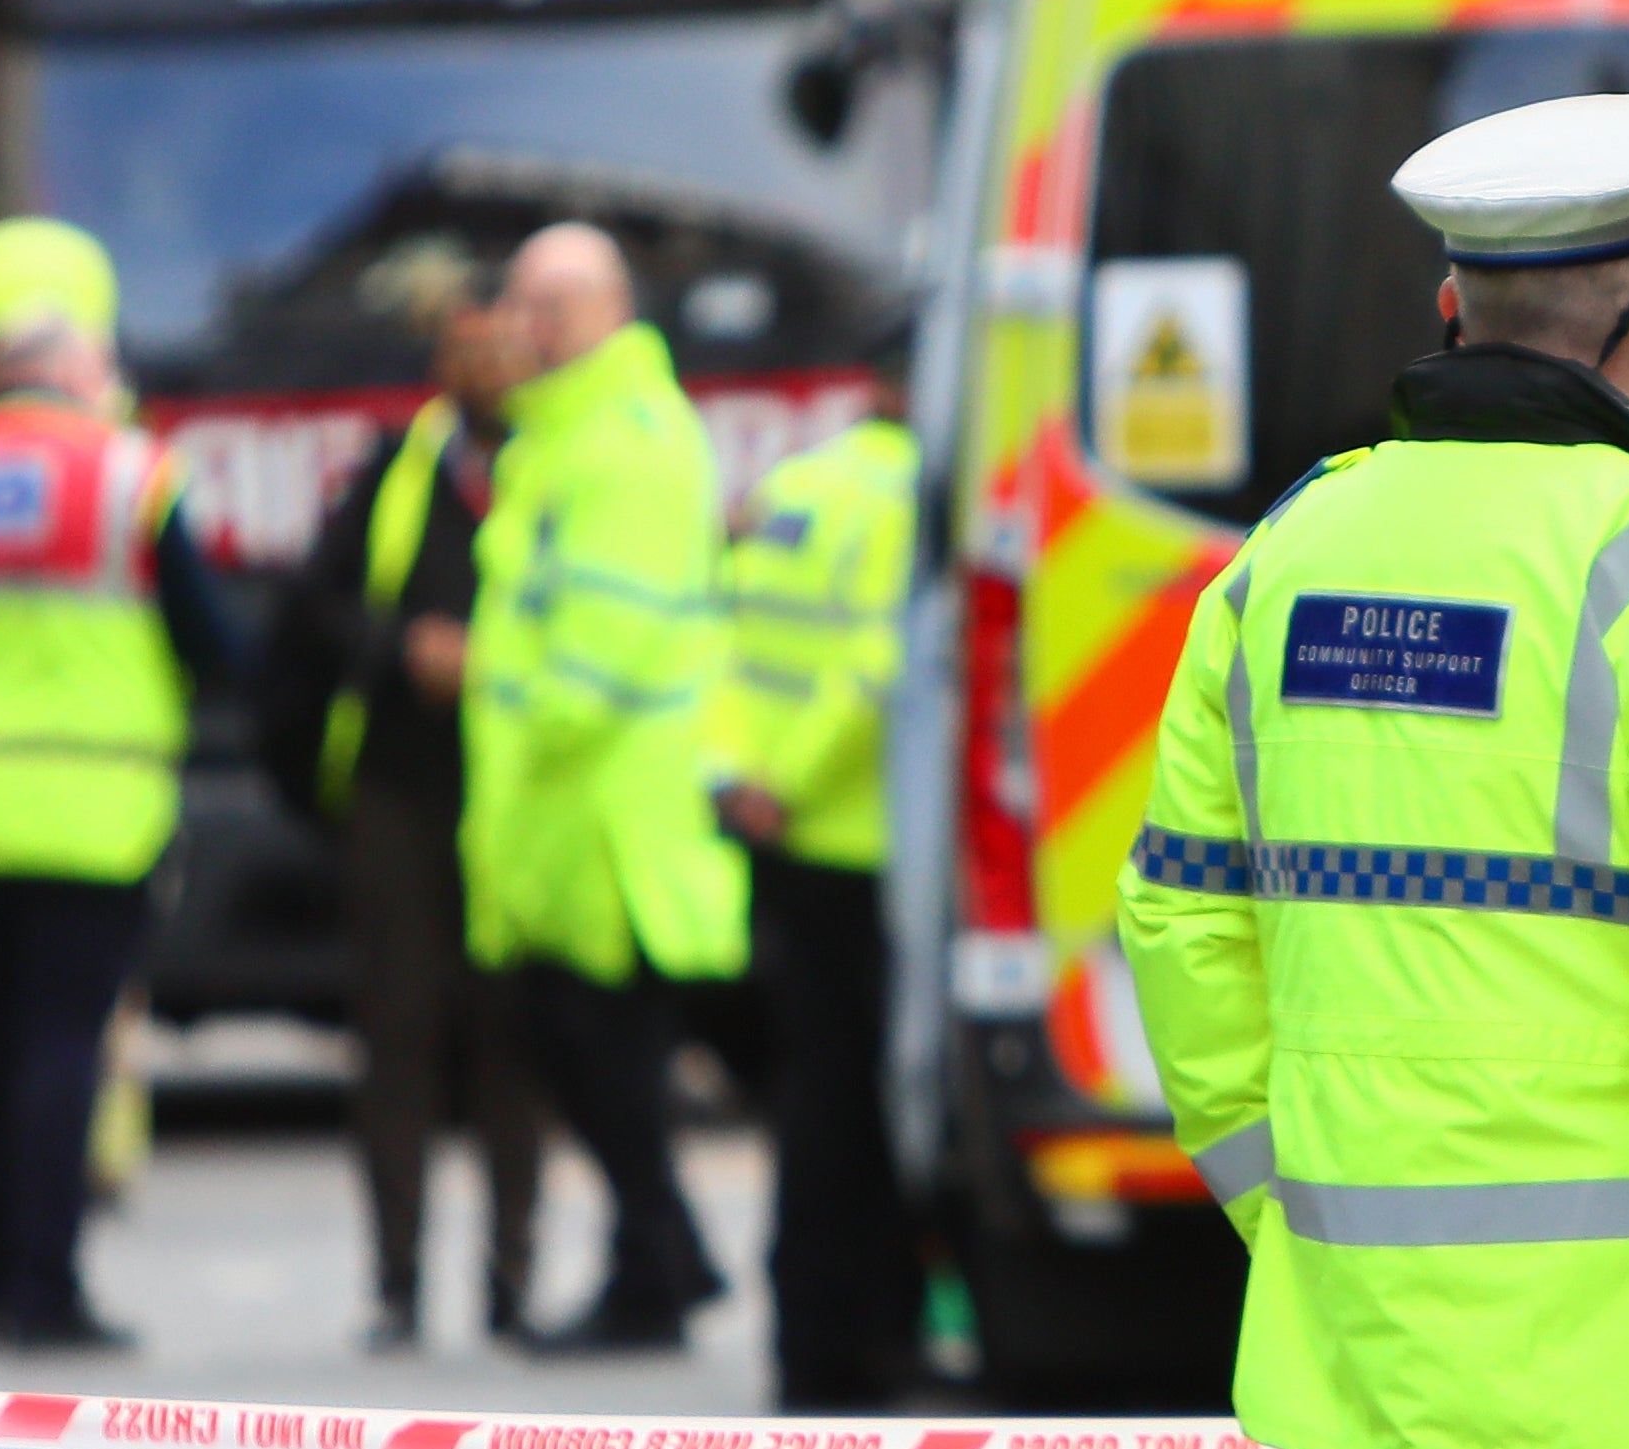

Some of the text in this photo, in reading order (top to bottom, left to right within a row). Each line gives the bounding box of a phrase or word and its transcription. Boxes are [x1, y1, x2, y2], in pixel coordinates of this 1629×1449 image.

[1341, 605, 1444, 643] POLICE
[1296, 644, 1484, 675] COMMUNITY SUPPORT
[1350, 672, 1419, 695] OFFICER
